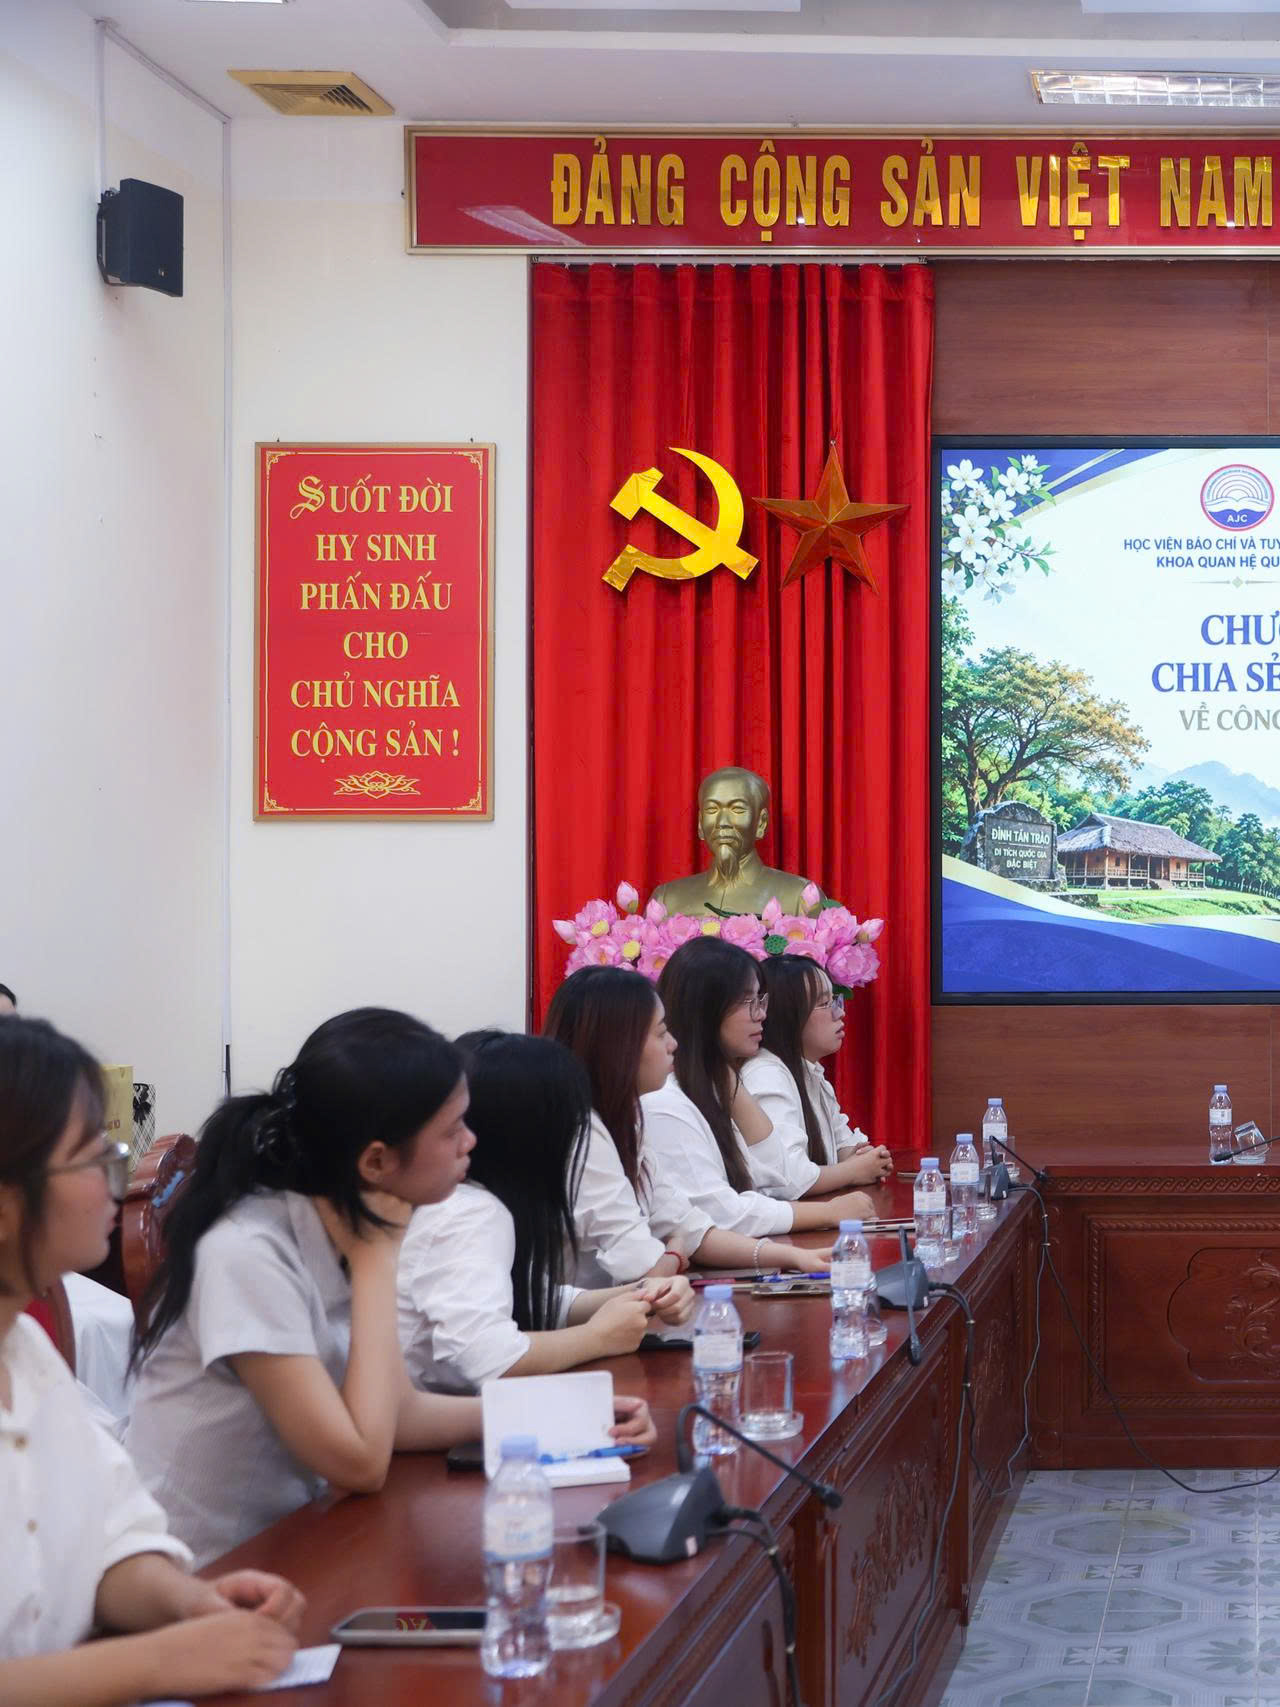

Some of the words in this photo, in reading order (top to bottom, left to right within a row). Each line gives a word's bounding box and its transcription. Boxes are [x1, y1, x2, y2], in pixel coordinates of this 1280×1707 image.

[551, 136, 685, 227] ĐẢNG
[720, 140, 851, 241] CỘNG
[881, 140, 981, 227] SẢN
[1016, 141, 1131, 240] VIỆT
[1160, 156, 1272, 230] NAM
[290, 474, 391, 519] SUỐT
[399, 478, 453, 512] ĐỜI
[1227, 514, 1248, 523] AJC
[316, 535, 358, 560] HY
[367, 534, 436, 561] SINH
[1124, 539, 1150, 552] HỌC
[1154, 536, 1182, 552] VIỆN
[1216, 536, 1236, 550] CHÍ
[1240, 536, 1256, 549] VÀ
[1157, 556, 1194, 567] KHOA
[1198, 556, 1235, 568] QUAN
[1240, 554, 1256, 570] HỆ
[301, 571, 382, 609] PHẤN
[390, 571, 452, 610] ĐẤU
[344, 632, 408, 658] CHO
[291, 672, 354, 708] CHỦ
[363, 675, 460, 707] NGHĨA
[1152, 663, 1237, 692] CHIA
[1179, 702, 1210, 730] VỀ
[291, 722, 377, 763] CỘNG
[386, 720, 443, 756] SẢN
